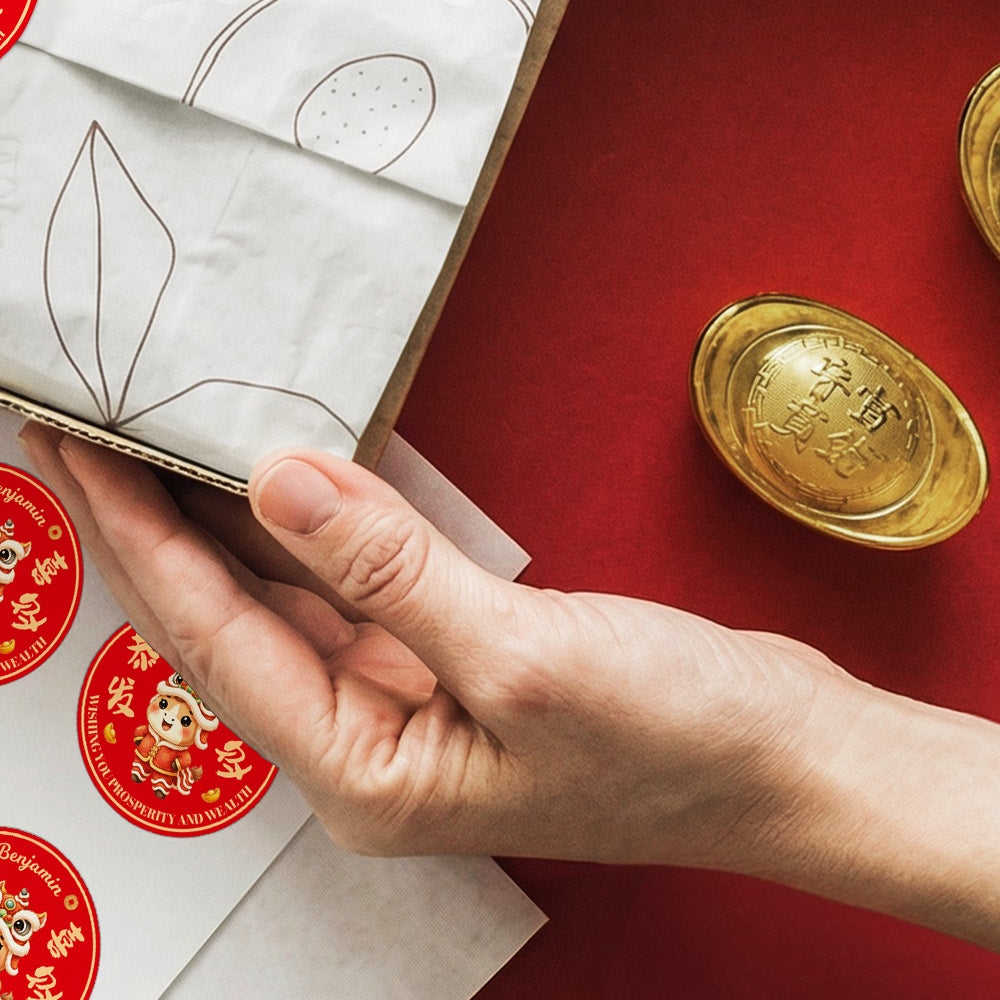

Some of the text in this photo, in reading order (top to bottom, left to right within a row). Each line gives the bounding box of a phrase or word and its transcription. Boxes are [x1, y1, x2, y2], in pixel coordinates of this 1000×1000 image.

[0, 636, 47, 671] WEALTH
[87, 694, 252, 825] WISHING YOU PROSPERITY AND WEALTH
